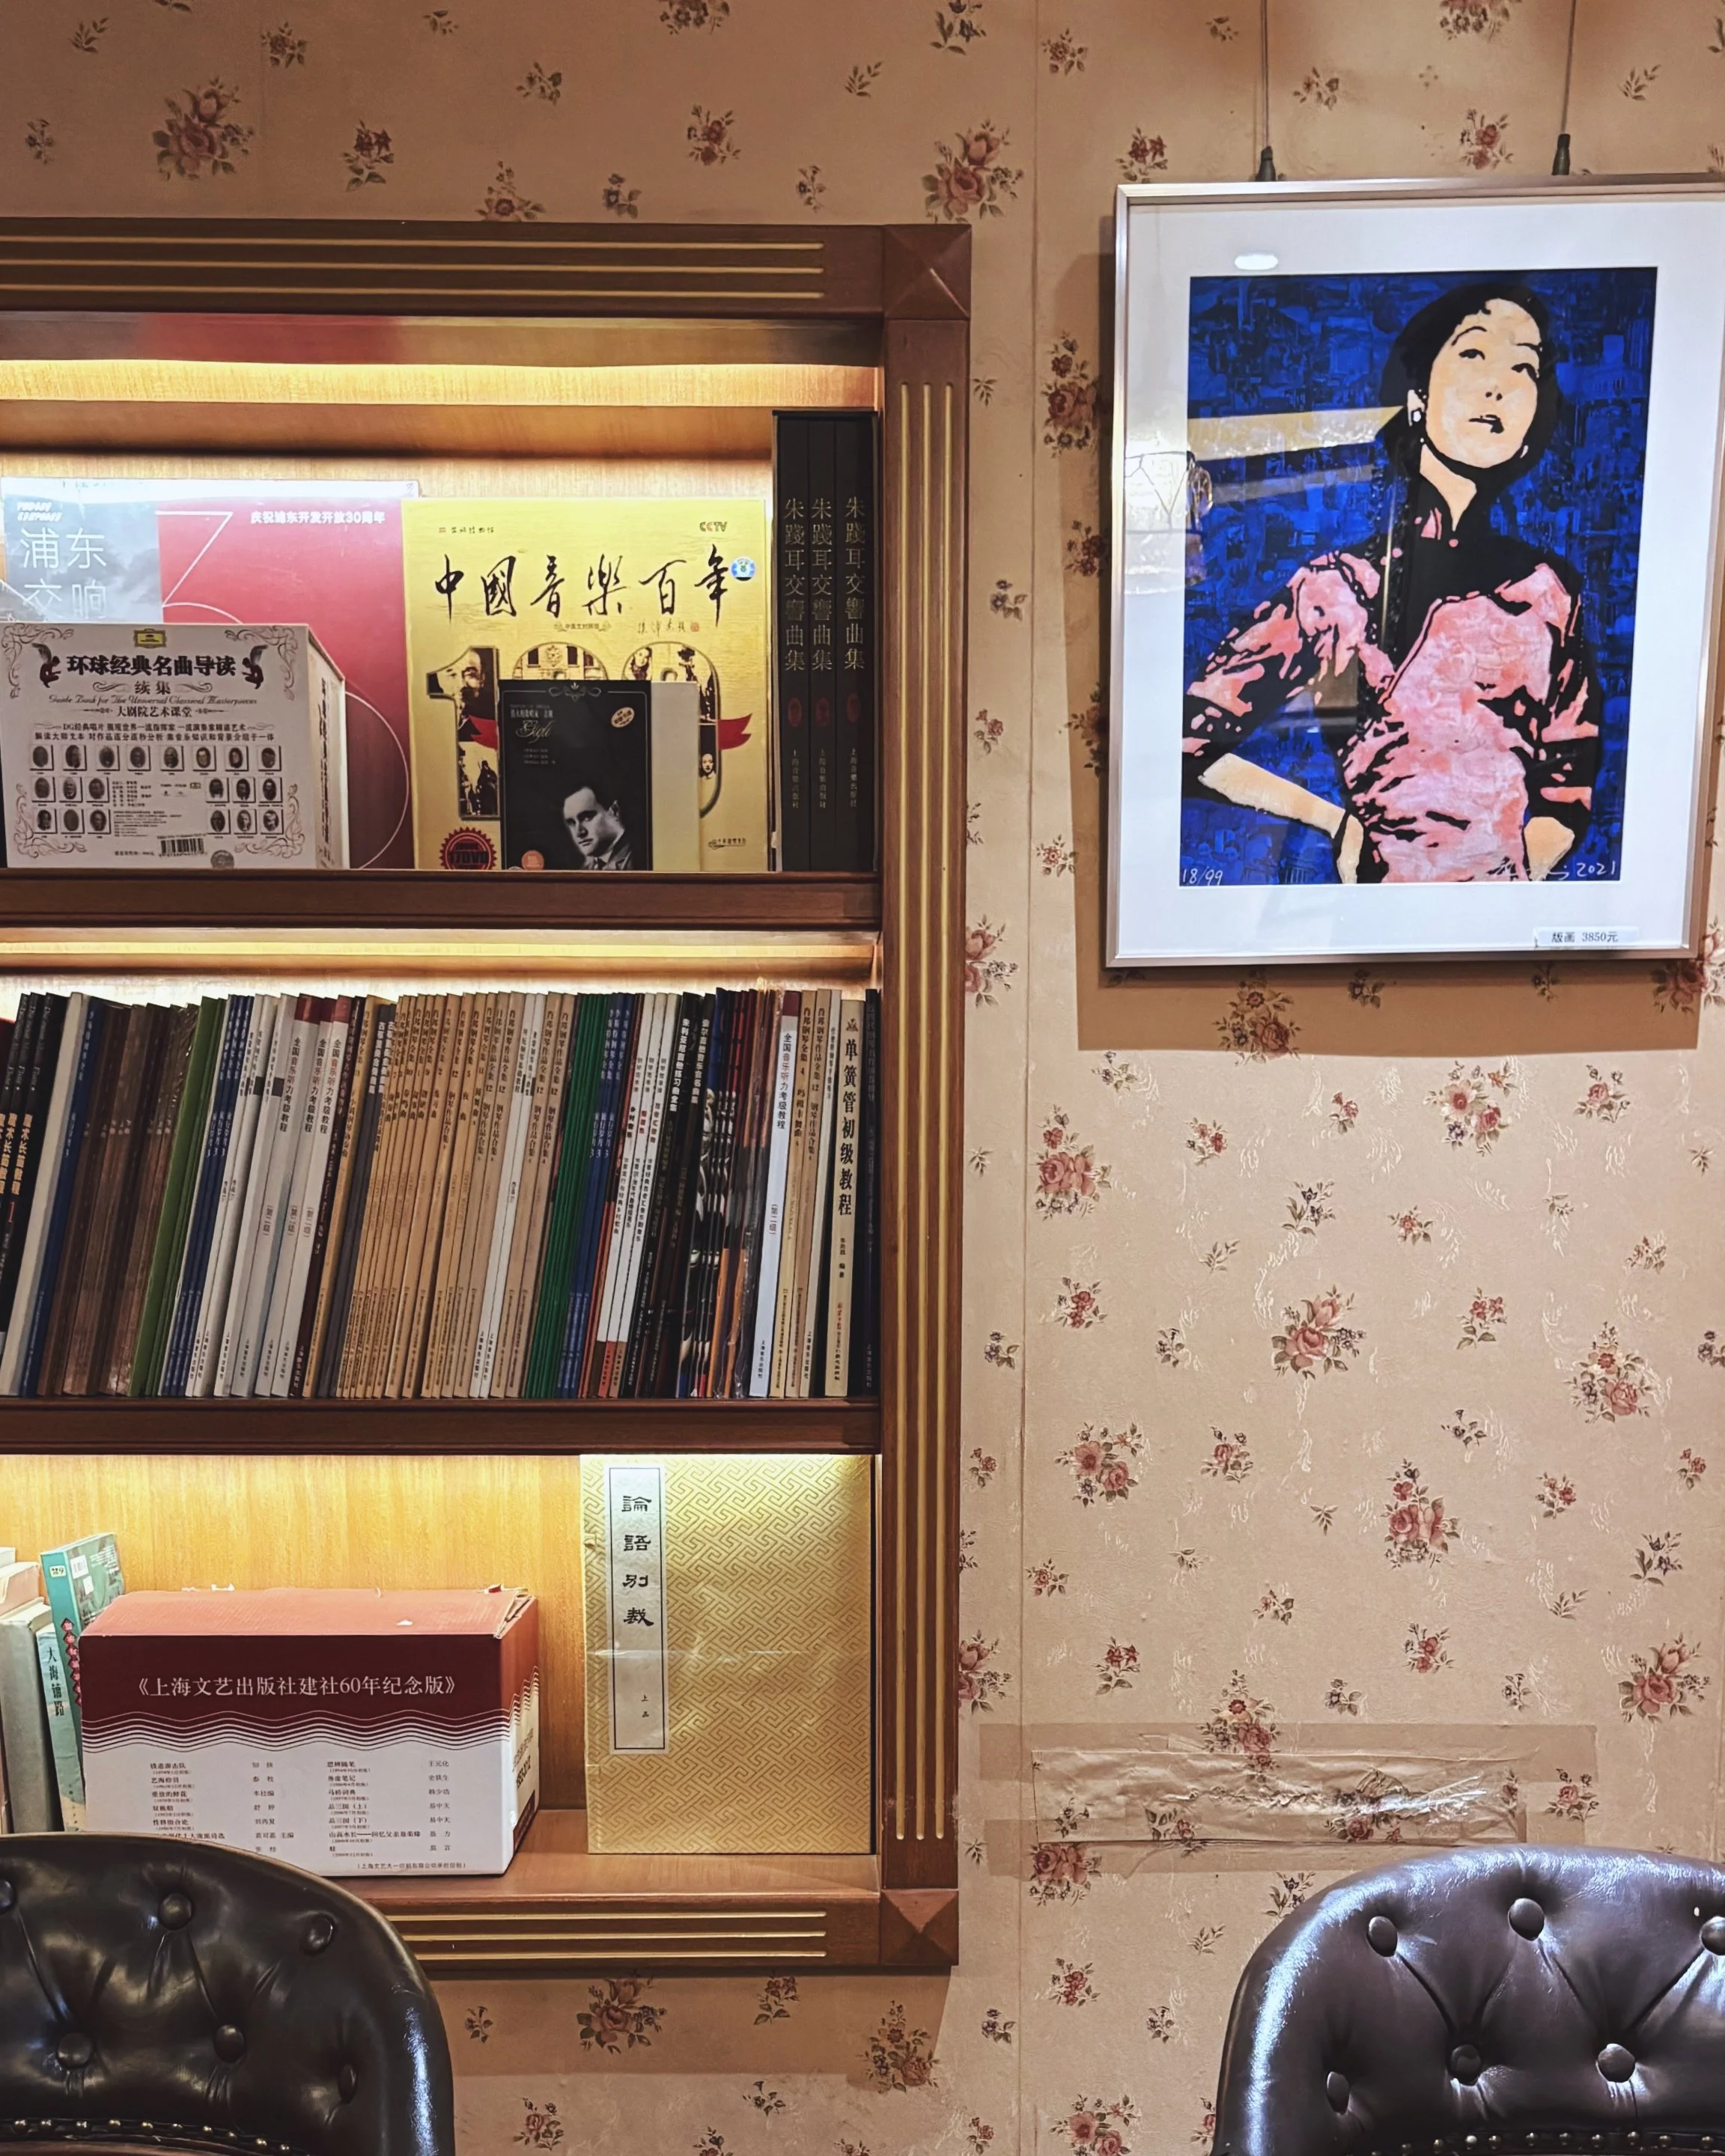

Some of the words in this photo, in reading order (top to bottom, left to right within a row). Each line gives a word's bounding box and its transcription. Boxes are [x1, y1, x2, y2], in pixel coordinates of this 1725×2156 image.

[251, 511, 385, 524] 庆祝浦东开发开放30周年
[699, 521, 728, 532] CCTV
[19, 527, 106, 569] 浦东
[23, 579, 106, 620] 交响
[67, 654, 237, 676] 环球经典名曲导读
[135, 680, 171, 695] 续集
[117, 707, 192, 717] 大剧院艺术课堂
[1182, 867, 1223, 887] 18/99
[1576, 860, 1616, 877] 2021
[1551, 932, 1575, 943] 版画
[1581, 931, 1619, 943] 3850元
[800, 1007, 812, 1062] 肖邦钢琴全集
[812, 1008, 826, 1079] 肖邦钢琴作品全集
[279, 1037, 301, 1133] 全国音乐听力考级教程
[304, 1038, 327, 1133] 全国音乐听力考级教程
[320, 1039, 343, 1134] 全国音乐听力考级教程
[777, 1033, 792, 1129] 全国音乐听力考级教程
[808, 1103, 819, 1154] 钢琴作品合集
[837, 1039, 858, 1216] 单簧管初级教程
[139, 1676, 456, 1696] 《上海文艺出版社建社60年纪念版》
